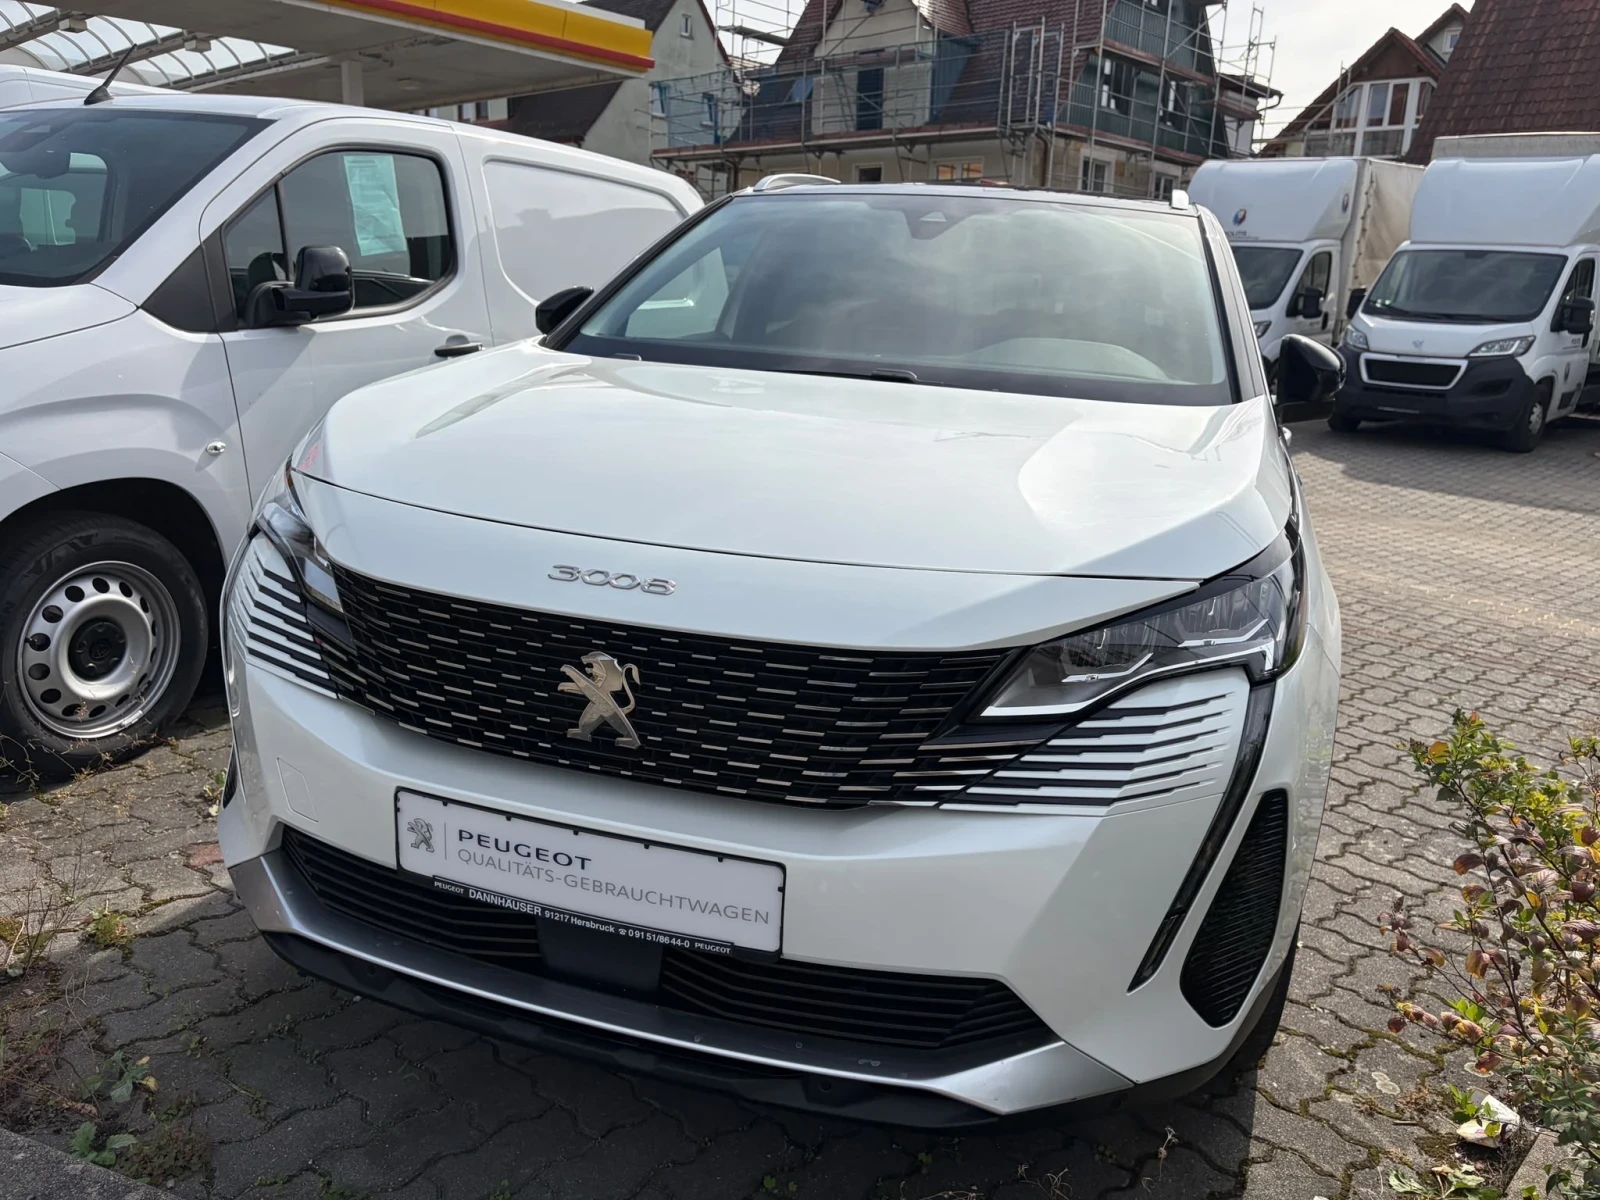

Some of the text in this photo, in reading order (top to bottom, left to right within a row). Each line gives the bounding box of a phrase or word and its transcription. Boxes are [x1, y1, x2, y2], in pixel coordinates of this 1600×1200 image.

[547, 564, 677, 596] 3008
[458, 829, 592, 871] PEUGEOT
[457, 848, 769, 925] QUALITÄTS-GEBRAUCHTWAGEN
[434, 881, 465, 894] PEUGEOT
[544, 910, 570, 923] 91217
[571, 916, 615, 934] Hersbruck
[694, 942, 732, 954] PEUGEOT
